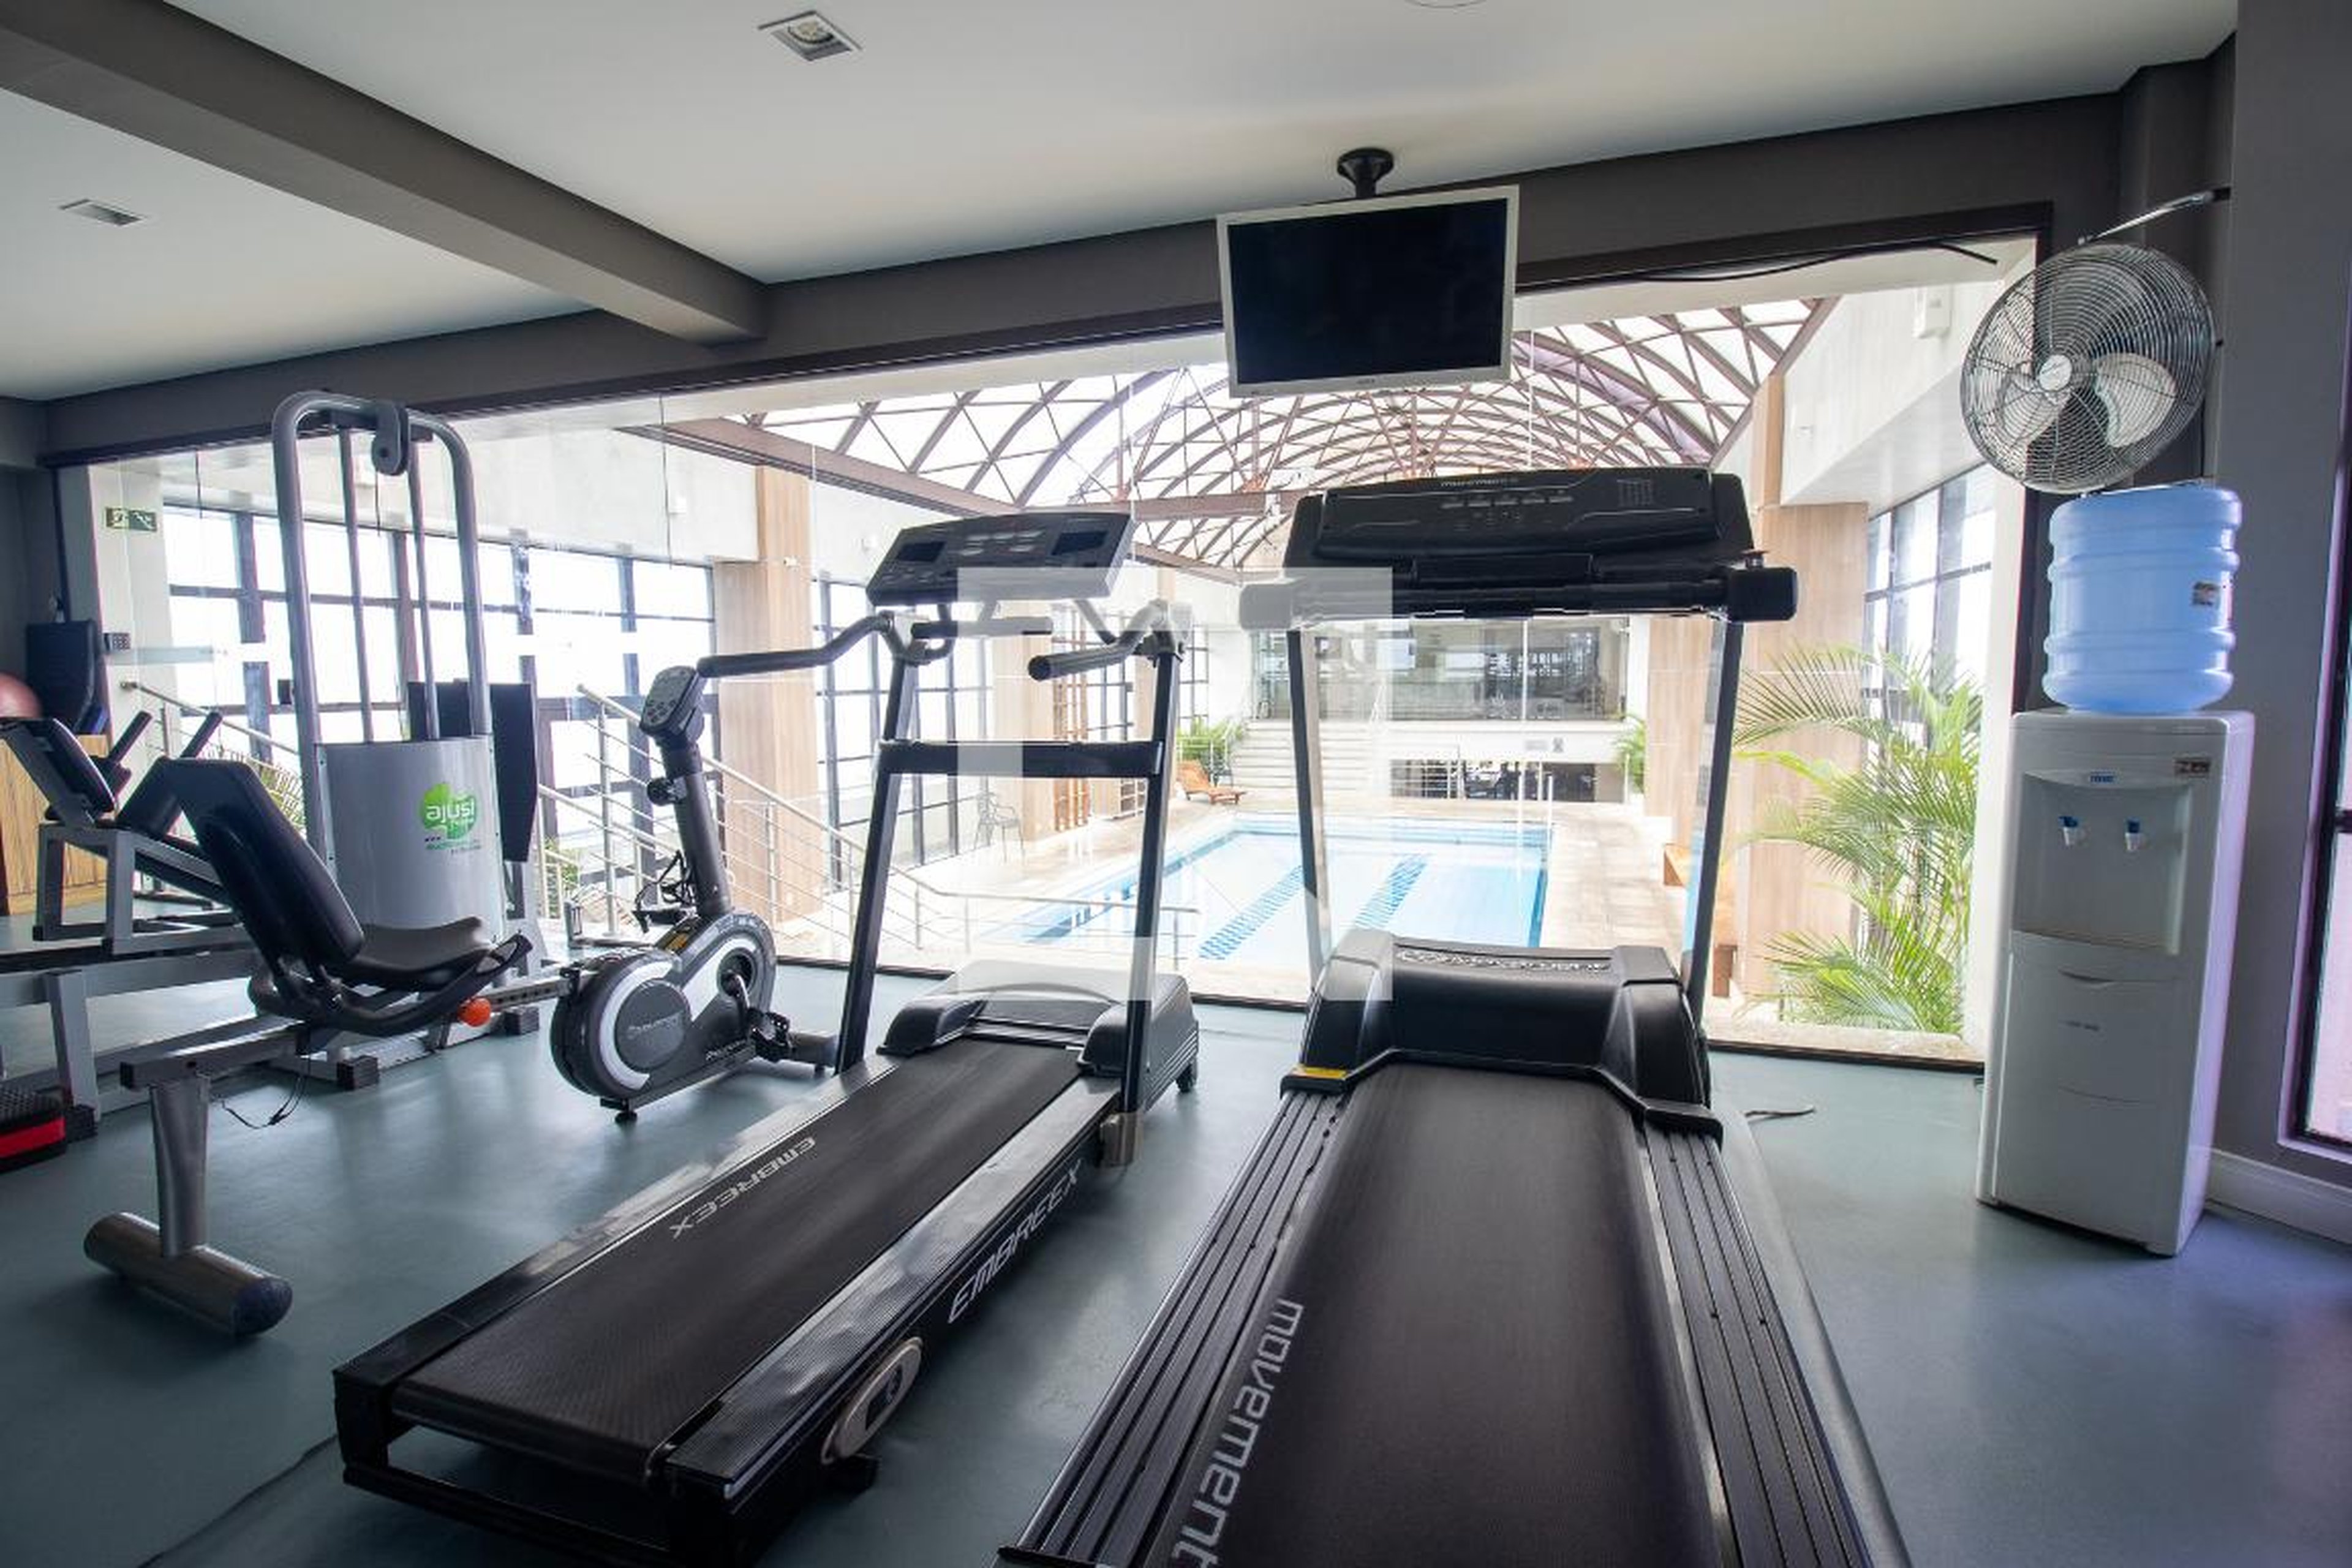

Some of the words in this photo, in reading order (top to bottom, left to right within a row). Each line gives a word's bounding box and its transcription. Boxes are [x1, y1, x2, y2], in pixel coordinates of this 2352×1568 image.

[669, 1137, 815, 1238] EMBREEX
[948, 1158, 1081, 1324] EMBREEX
[1172, 1298, 1304, 1568] movement
